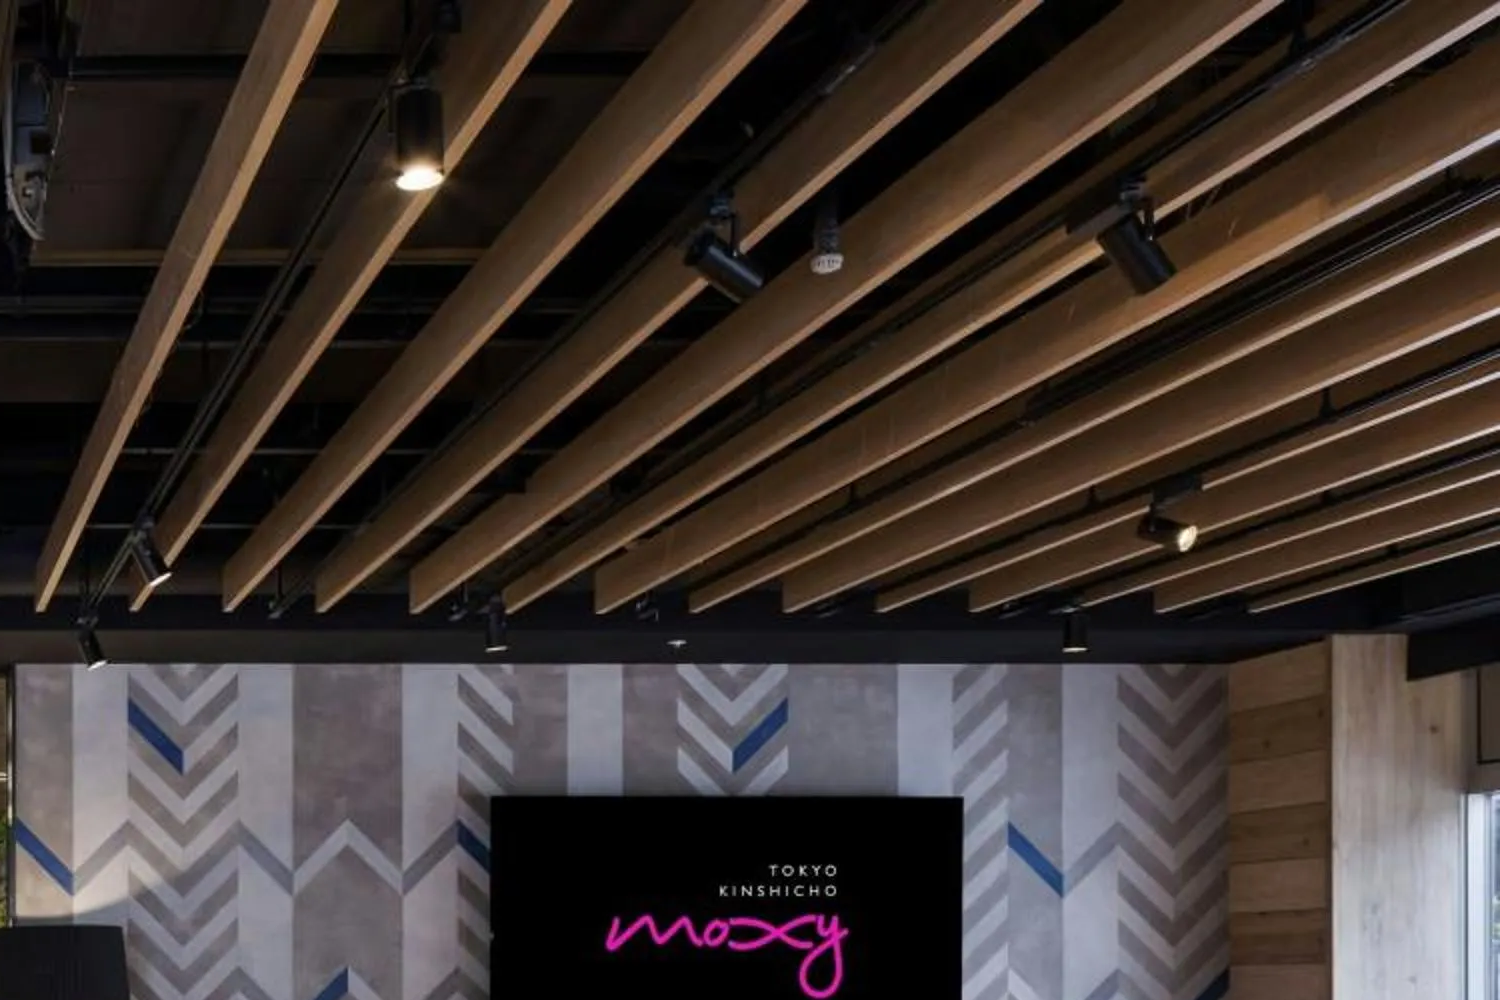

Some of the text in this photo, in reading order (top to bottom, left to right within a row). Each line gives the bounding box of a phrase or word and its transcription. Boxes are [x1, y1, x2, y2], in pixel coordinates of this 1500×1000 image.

[768, 864, 838, 877] TOKYO
[718, 885, 838, 898] KINSHICHO
[605, 913, 849, 999] moxy
